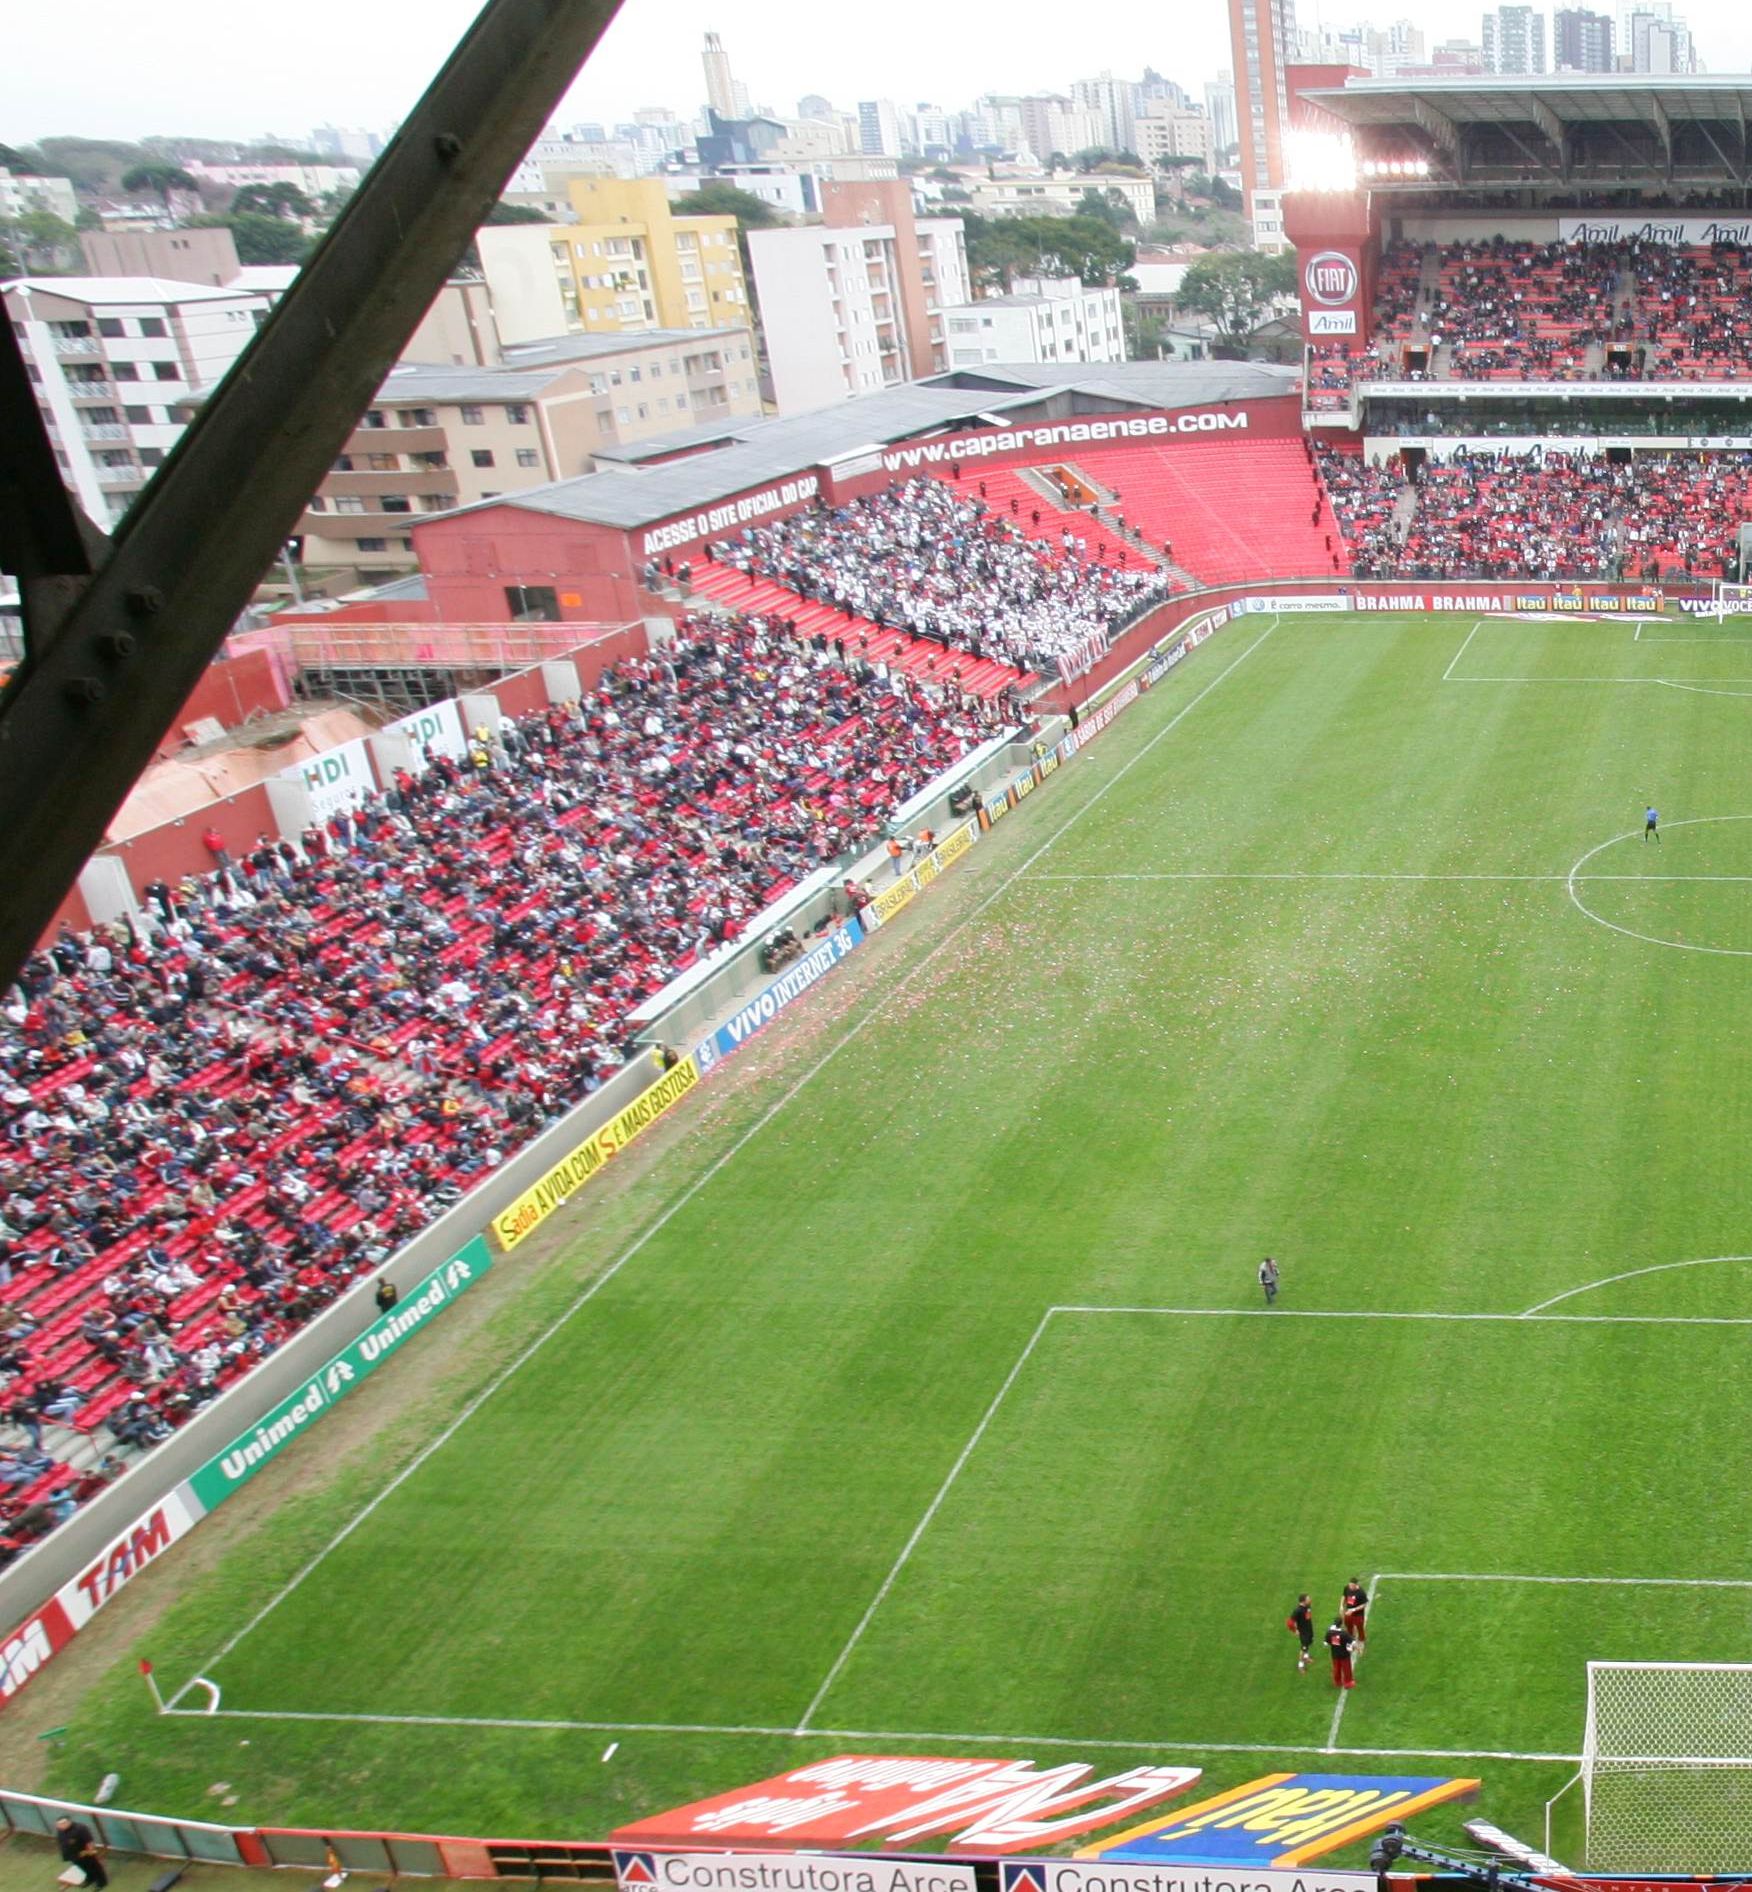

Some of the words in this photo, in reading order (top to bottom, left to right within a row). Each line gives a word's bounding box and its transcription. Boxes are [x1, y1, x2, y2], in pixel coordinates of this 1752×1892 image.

[1570, 223, 1619, 241] Amil
[1637, 223, 1684, 241] Amil
[1701, 223, 1749, 241] Amil
[1317, 268, 1346, 291] FIAT
[1314, 316, 1352, 330] Amil
[644, 518, 697, 554] ACESSE
[699, 515, 709, 535] O
[710, 503, 738, 532] SITE
[738, 489, 782, 520] OFICIAL
[781, 483, 797, 505] DO
[797, 476, 819, 499] CAP
[1357, 595, 1424, 611] BRAHMA
[1433, 595, 1501, 610] BRAHMA
[1517, 596, 1546, 610] Itaú
[1553, 596, 1582, 610] Itaú
[1590, 596, 1619, 610] Itaú
[1626, 596, 1656, 611] Itaú
[303, 753, 350, 791] HDI
[727, 993, 775, 1042] VIVO
[771, 941, 837, 1009] INTERNET
[833, 928, 853, 957] 3G
[500, 1202, 538, 1242] Sadia
[535, 1190, 550, 1214] A
[543, 1165, 576, 1204] VIDA
[571, 1141, 602, 1181] COM
[620, 1102, 651, 1141] MAIS
[650, 1061, 697, 1116] GOSTOSA
[358, 1279, 446, 1362] Unimed
[220, 1383, 324, 1481] Unimed
[77, 1507, 171, 1609] TAM
[1158, 1787, 1412, 1845] Itaú
[664, 1858, 876, 1892] Construtora
[889, 1867, 969, 1892] Arce
